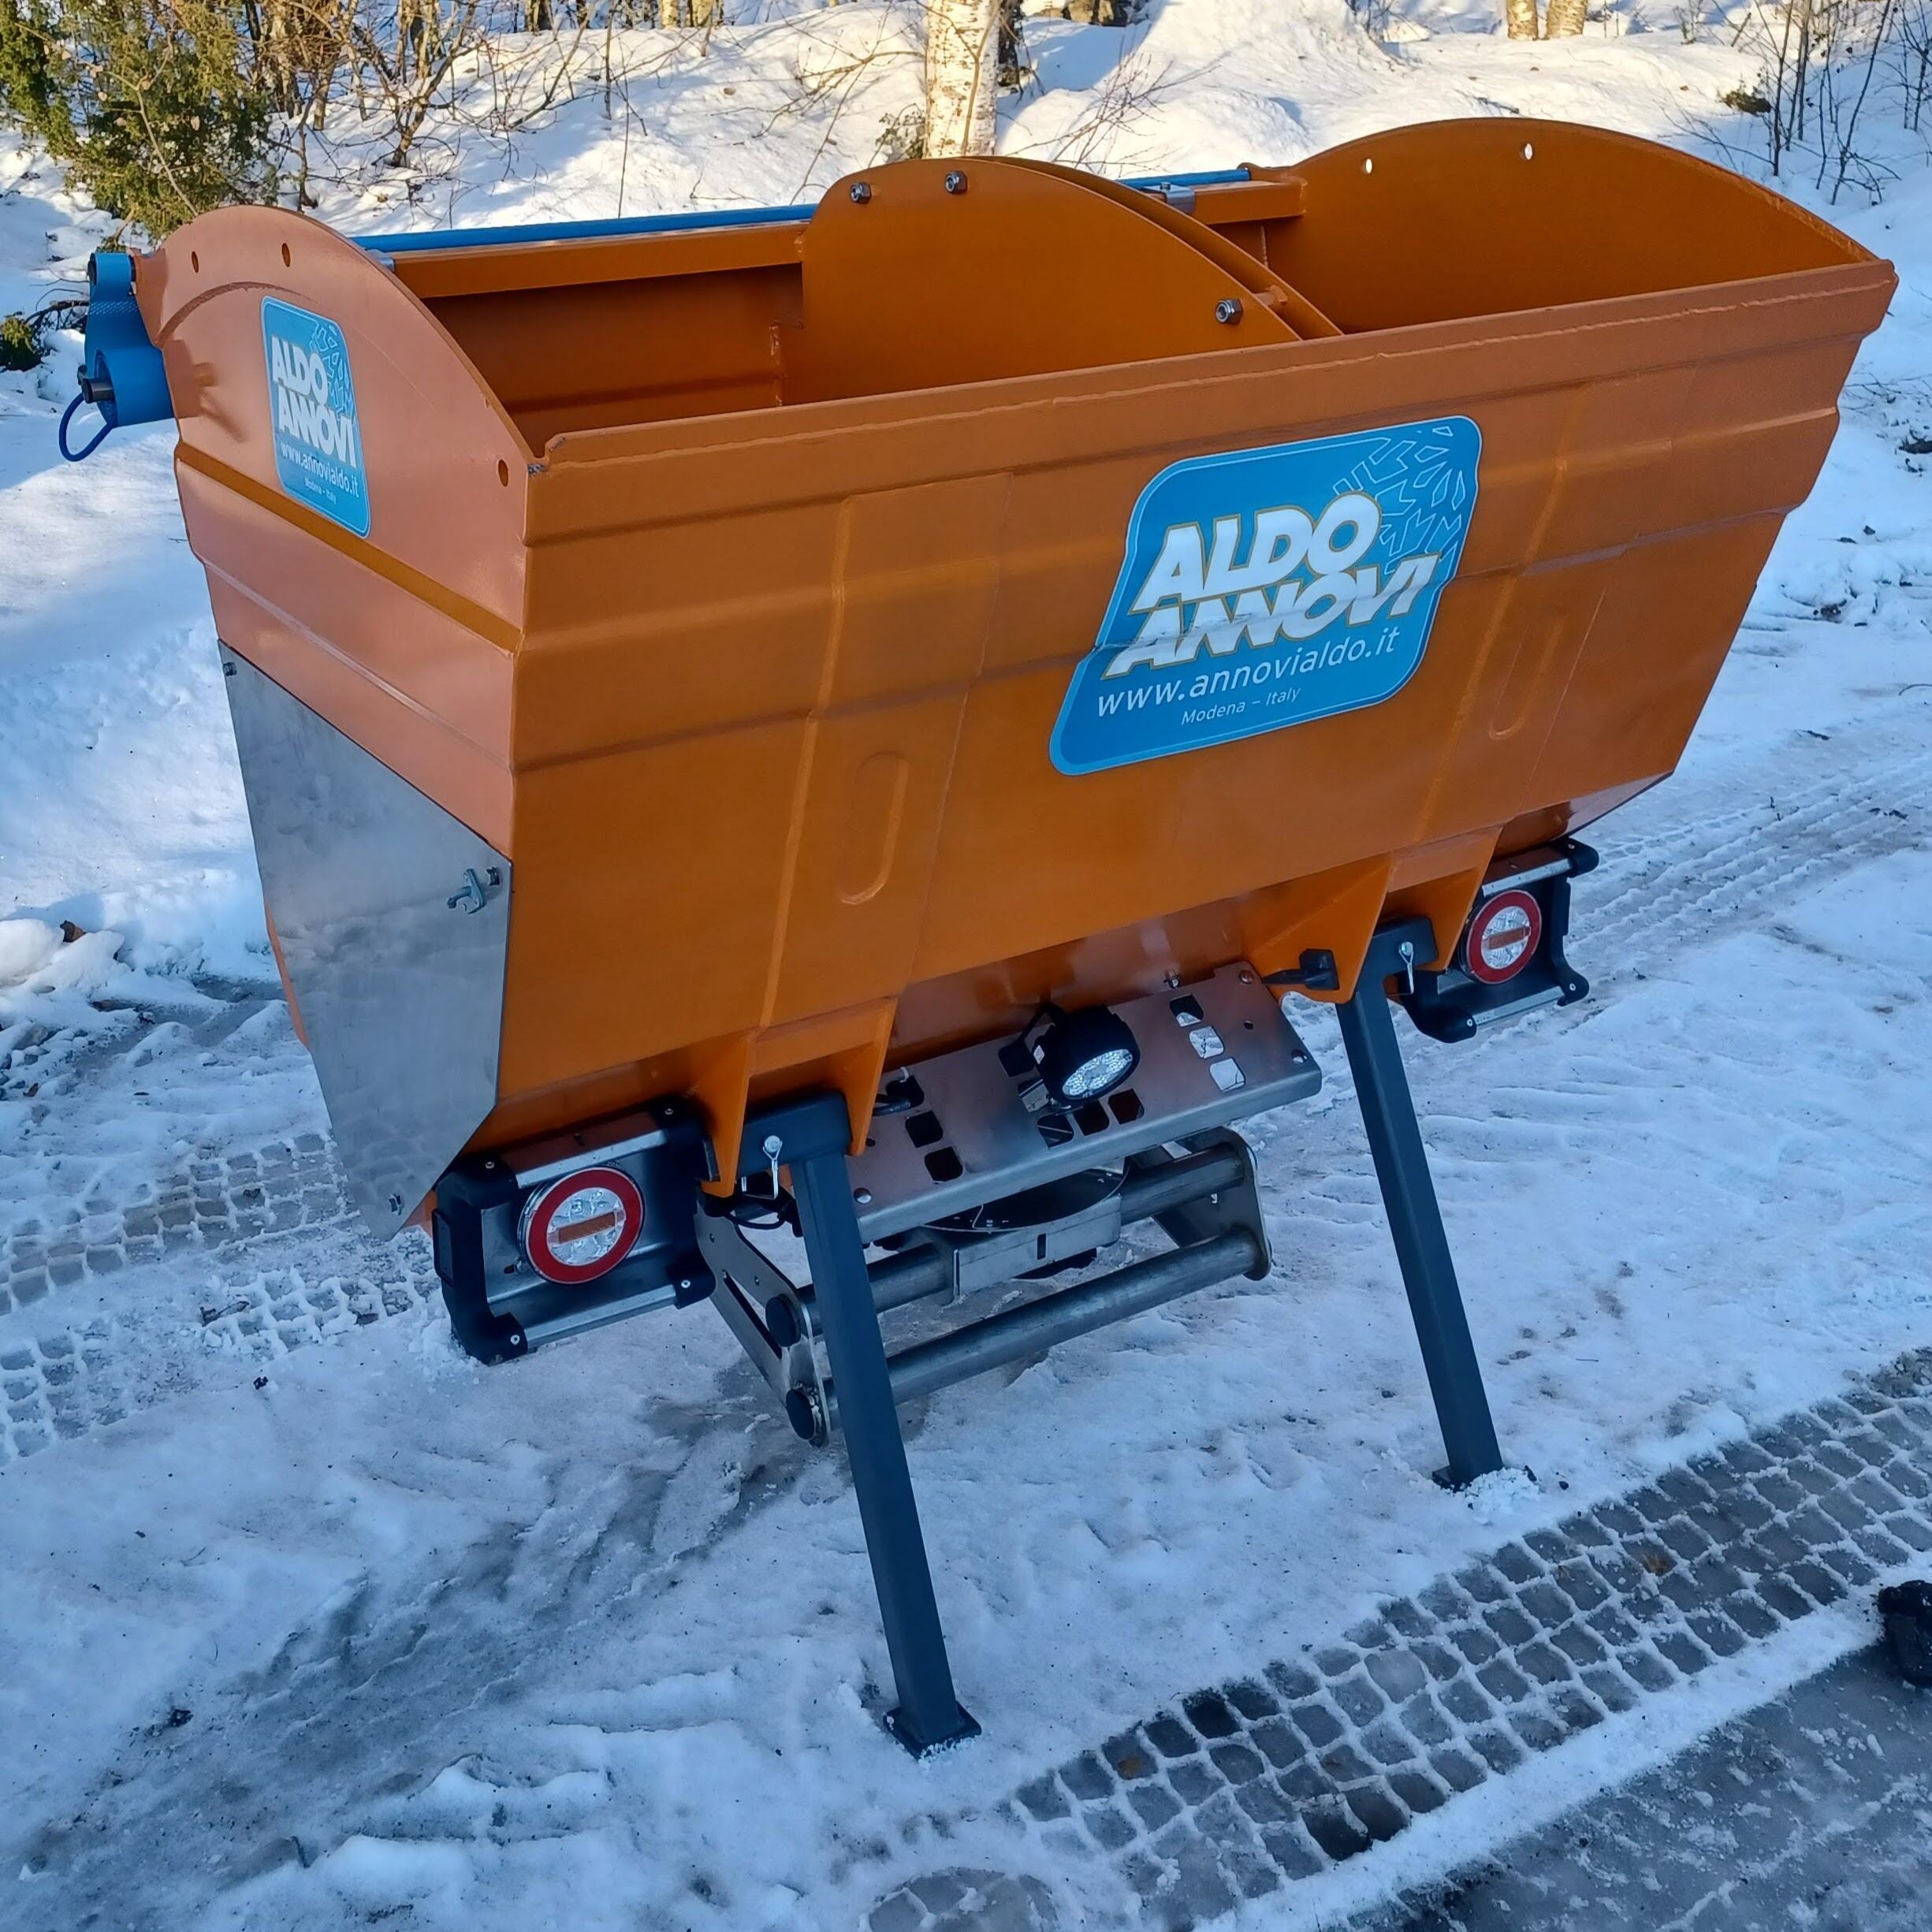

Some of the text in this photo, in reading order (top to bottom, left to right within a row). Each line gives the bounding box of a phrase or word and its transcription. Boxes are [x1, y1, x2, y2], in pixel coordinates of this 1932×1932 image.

[271, 336, 329, 406] ALDO
[278, 385, 356, 468] ANNOVI
[281, 441, 359, 498] www.annovialdo.it
[1128, 492, 1383, 614] ALDO
[1100, 551, 1442, 679] ANNOVI
[1097, 627, 1400, 717] www.annovialdo.it
[1181, 701, 1245, 725] Modena
[1265, 687, 1301, 706] Italy
